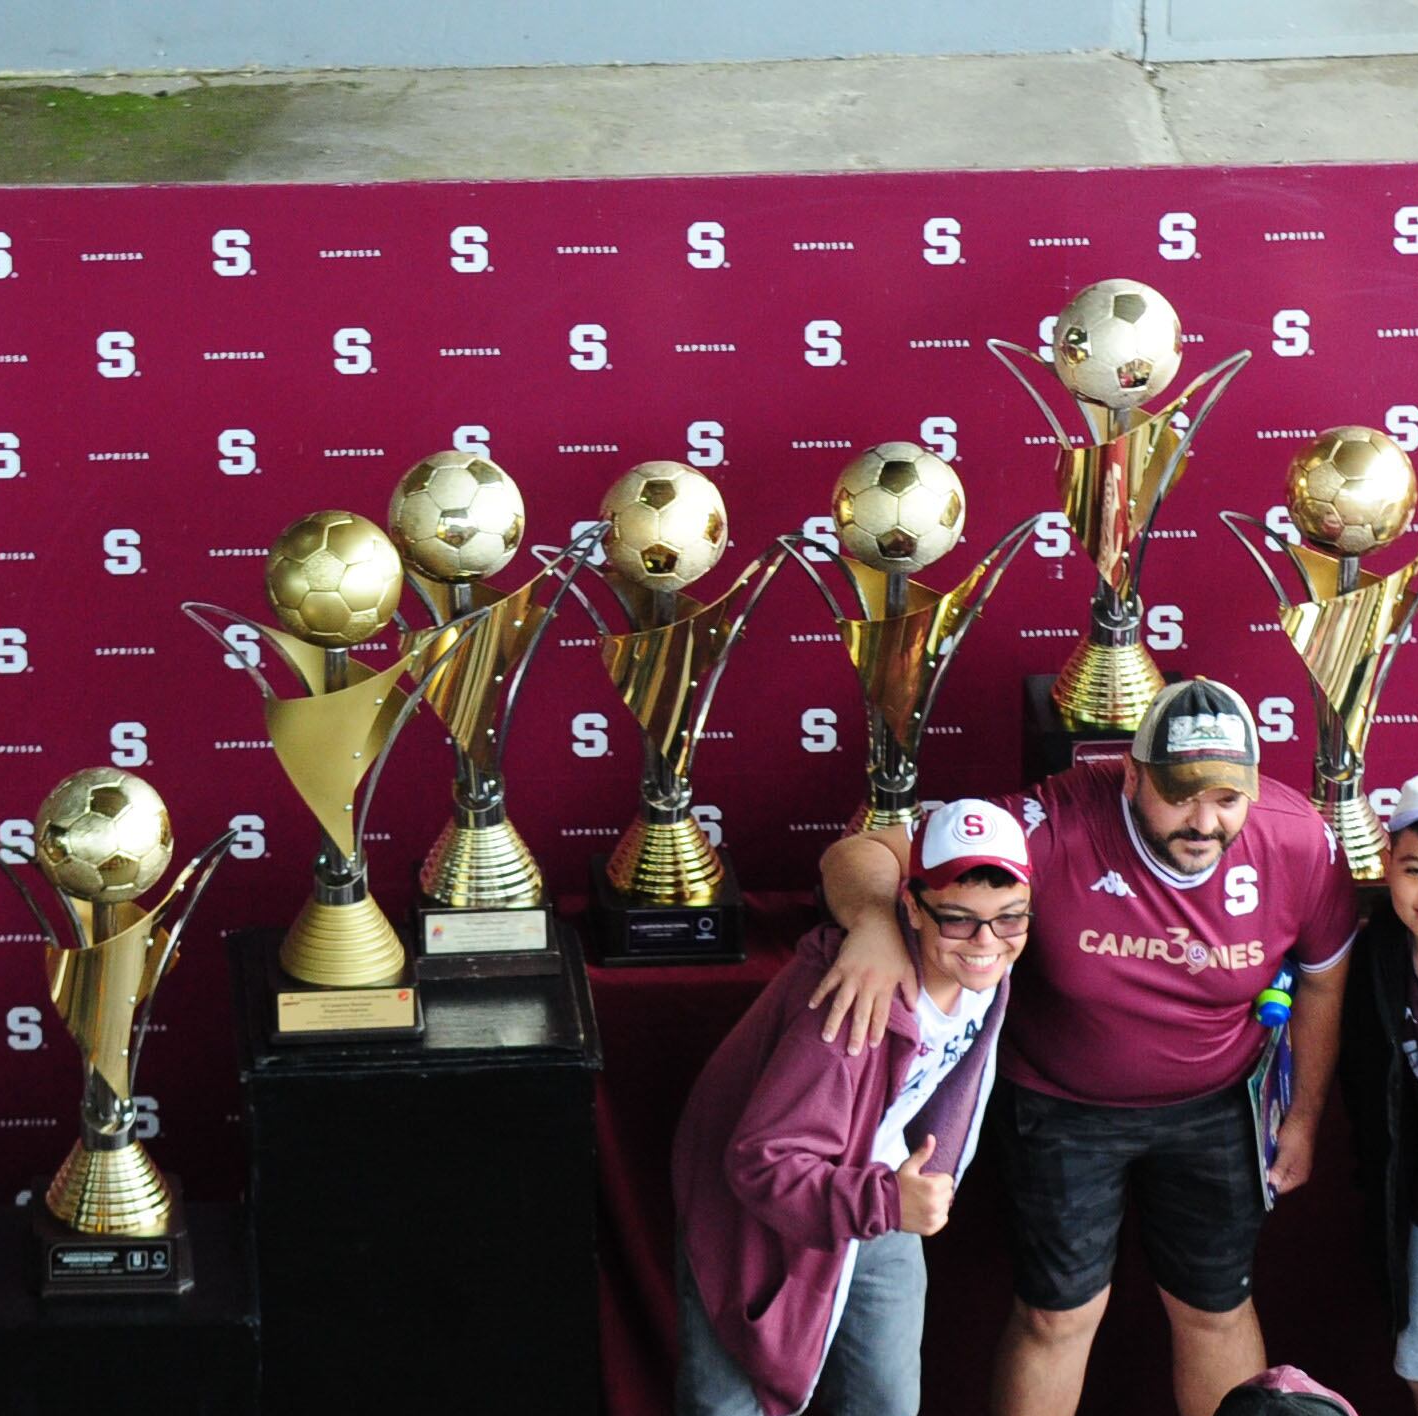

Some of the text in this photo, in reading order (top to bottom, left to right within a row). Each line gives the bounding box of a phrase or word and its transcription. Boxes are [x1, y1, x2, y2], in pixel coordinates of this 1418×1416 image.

[80, 252, 144, 262] SAPRISSA
[212, 229, 251, 276] S
[318, 249, 382, 259] SAPRISSA
[450, 226, 488, 273] S
[556, 245, 619, 255] SAPRISSA
[687, 222, 725, 269] S
[792, 241, 855, 251] SAPRISSA
[923, 217, 960, 265] S
[1028, 237, 1091, 247] SAPRISSA
[1158, 212, 1195, 260] S
[1263, 231, 1326, 242] SAPRISSA
[96, 331, 135, 378] S
[333, 328, 372, 374] S
[439, 347, 502, 357] SAPRISSA
[569, 324, 607, 370] S
[674, 343, 737, 353] SAPRISSA
[804, 320, 841, 367] S
[909, 339, 971, 349] SAPRISSA
[1272, 309, 1309, 357] S
[202, 351, 266, 361] SAPRISSA
[87, 451, 150, 462] SAPRISSA
[218, 429, 256, 475] S
[323, 448, 385, 458] SAPRISSA
[557, 444, 619, 454] SAPRISSA
[687, 421, 724, 467] S
[791, 439, 852, 449] SAPRISSA
[920, 417, 957, 463] S
[1257, 430, 1316, 439] SAPRISSA
[803, 517, 839, 561] S
[1035, 512, 1070, 557] S
[1265, 506, 1301, 551] S
[103, 529, 141, 575] S
[209, 549, 269, 557] SAPRISSA
[223, 625, 261, 670] S
[1020, 628, 1080, 639] SAPRISSA
[1147, 606, 1183, 650] S
[94, 646, 156, 656] SAPRISSA
[572, 713, 607, 757] S
[801, 708, 836, 752] S
[1258, 697, 1294, 742] S
[110, 722, 147, 767] S
[215, 740, 274, 749] SAPRISSA
[229, 815, 265, 859] S
[561, 828, 619, 837] SAPRISSA
[789, 822, 846, 831] SAPRISSA
[964, 814, 984, 836] S
[1224, 864, 1259, 916] S
[6, 1006, 40, 1050] S
